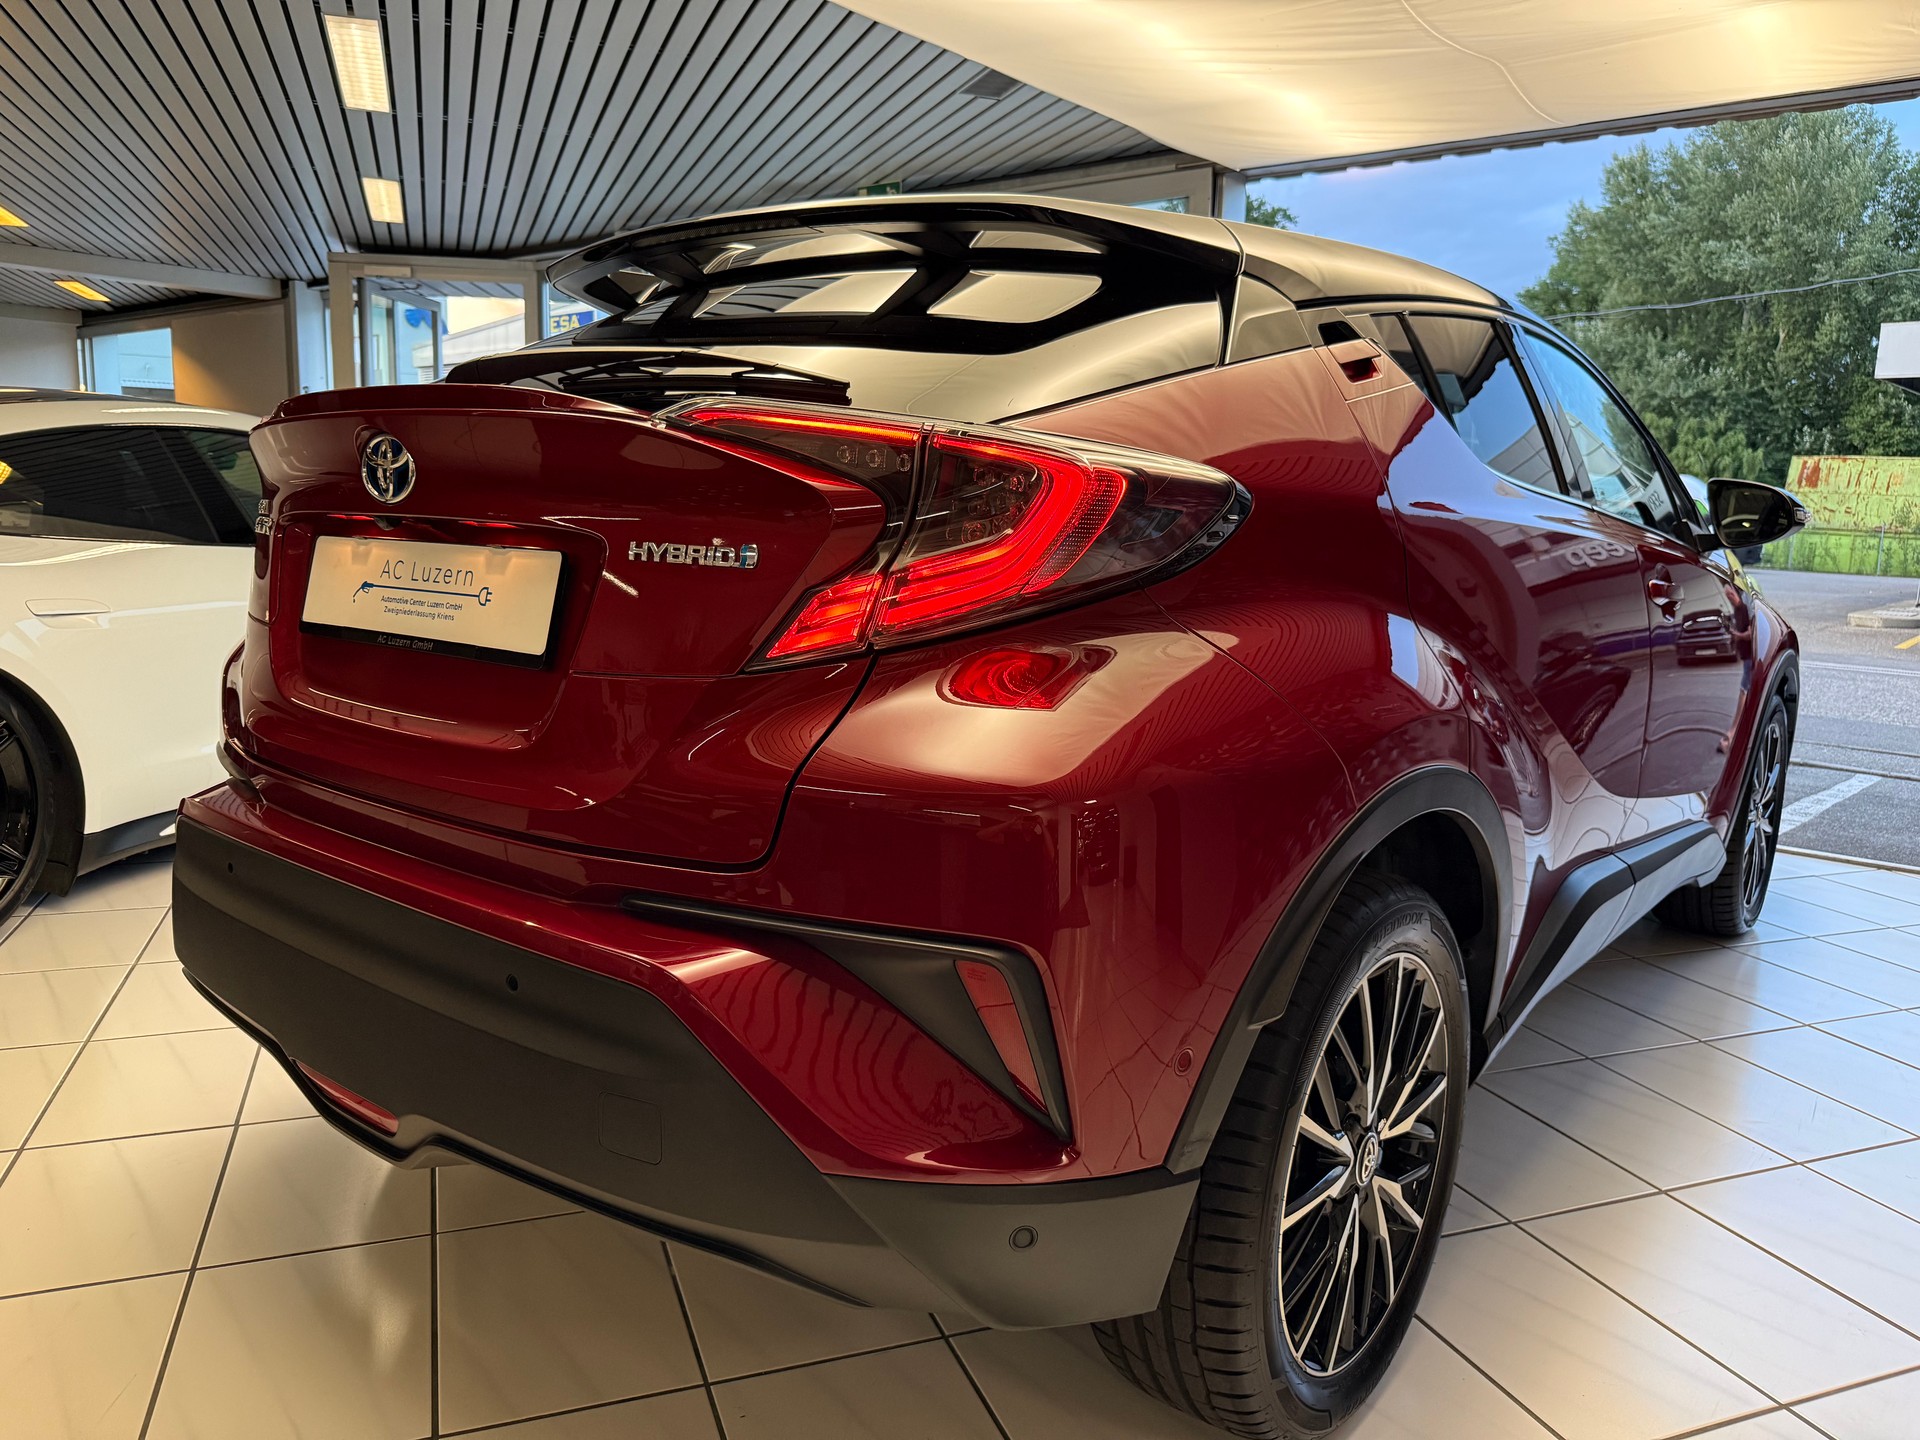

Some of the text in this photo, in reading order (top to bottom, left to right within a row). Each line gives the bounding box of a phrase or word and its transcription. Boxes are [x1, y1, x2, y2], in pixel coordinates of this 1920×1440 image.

[551, 315, 580, 333] ESA
[628, 541, 736, 567] HYBRID
[380, 559, 474, 586] AC Luzern
[381, 595, 463, 611] Automotive Center Luzern GmbH
[384, 606, 455, 621] Zweigniederlassung Kriens
[377, 635, 434, 651] AC Luzern GmbH
